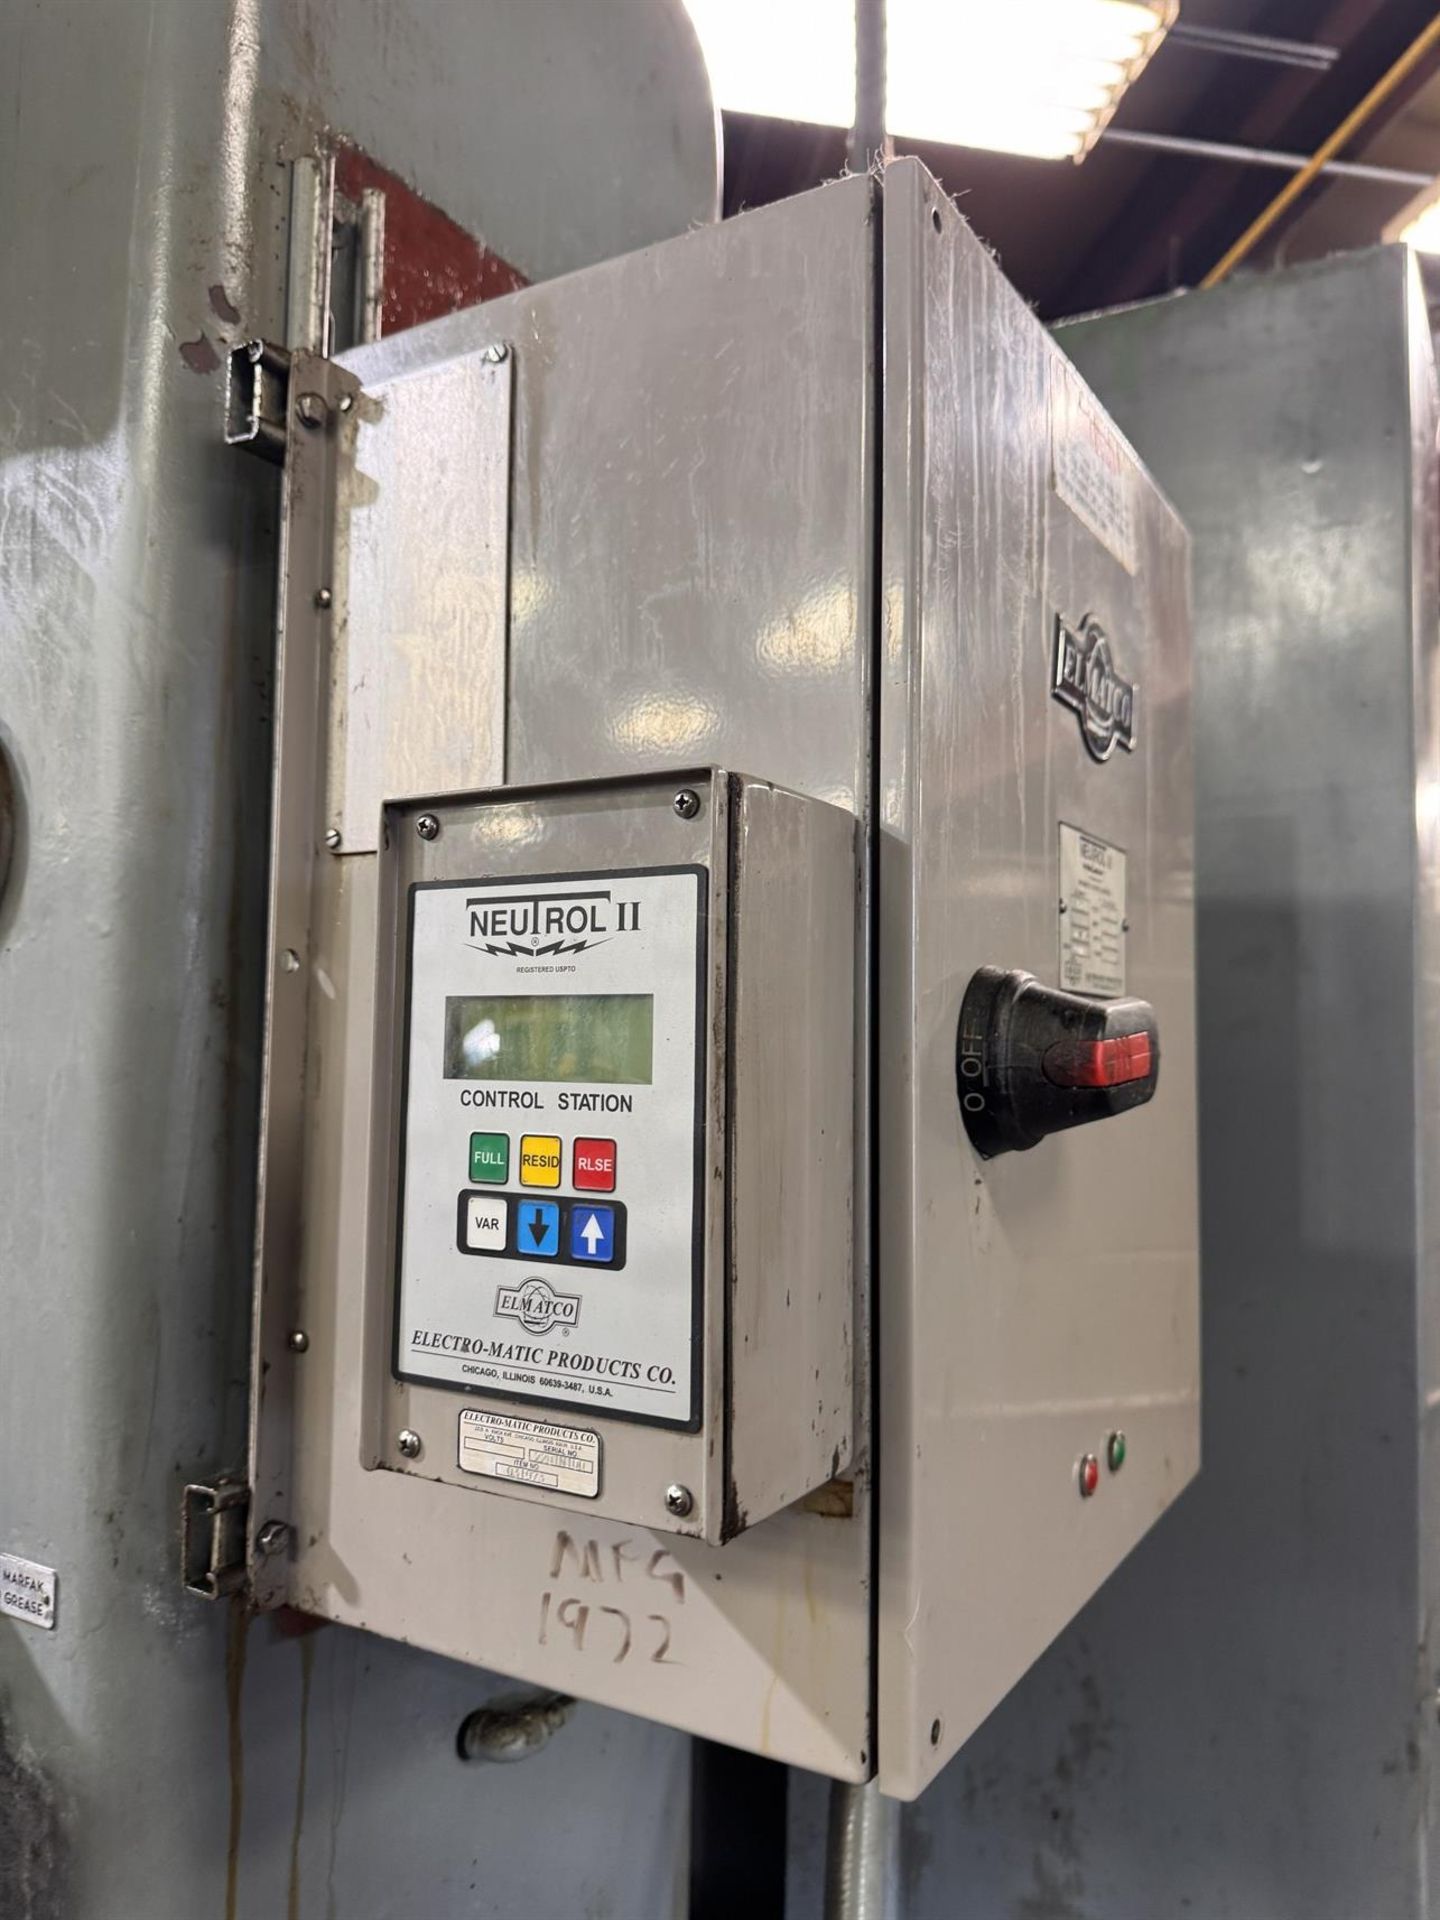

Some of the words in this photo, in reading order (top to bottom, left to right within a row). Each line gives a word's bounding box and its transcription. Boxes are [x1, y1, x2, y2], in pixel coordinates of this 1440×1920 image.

[466, 891, 611, 937] NEUTROL
[616, 901, 641, 932] II
[555, 965, 576, 973] USPTO
[960, 1023, 983, 1077] OFF
[460, 1089, 544, 1110] CONTROL
[558, 1092, 633, 1113] STATION
[474, 1151, 504, 1166] FULL
[522, 1153, 560, 1168] RESID
[578, 1158, 613, 1173] RLSE
[475, 1216, 500, 1231] VAR
[500, 1294, 574, 1318] ELMATCO
[411, 1329, 544, 1364] ELECTRO-MATIC
[546, 1349, 642, 1380] PRODUCTS
[646, 1365, 676, 1385] CO.
[461, 1364, 500, 1379] CHICAGO,
[502, 1371, 536, 1384] ILLINOIS
[588, 1384, 614, 1397] U.S.A.
[464, 1411, 531, 1431] ELECTRO-MATIC
[533, 1424, 579, 1441] PRODUCTS
[580, 1433, 596, 1444] CO.
[484, 1433, 504, 1443] VOLTS
[4, 1591, 44, 1616] GREASE
